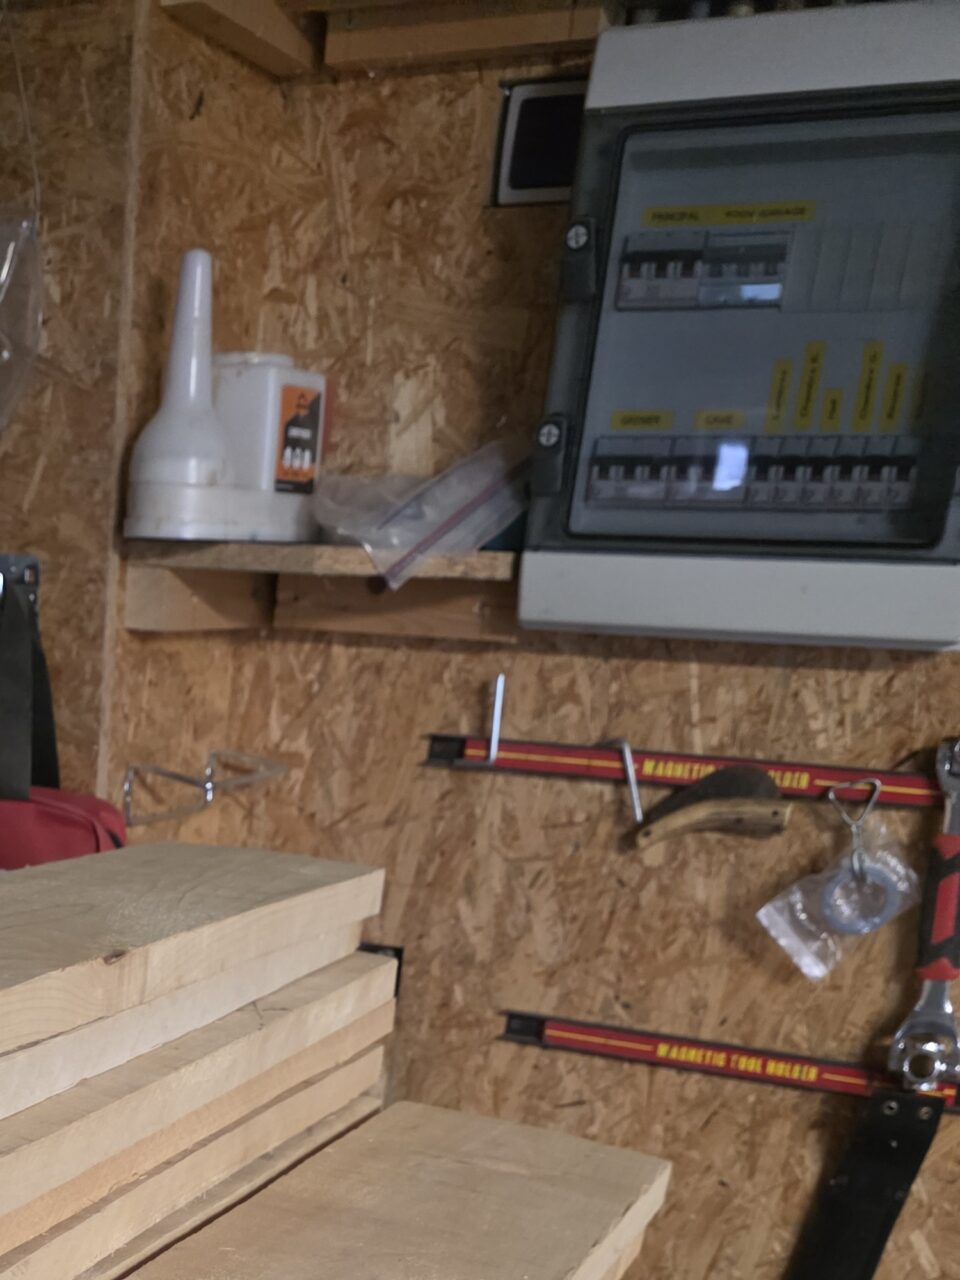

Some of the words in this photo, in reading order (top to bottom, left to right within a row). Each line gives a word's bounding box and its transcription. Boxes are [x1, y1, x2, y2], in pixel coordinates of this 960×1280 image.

[656, 1042, 727, 1068] MAGNETIC
[730, 1053, 763, 1074] TOOL
[766, 1058, 819, 1083] HOLDER
